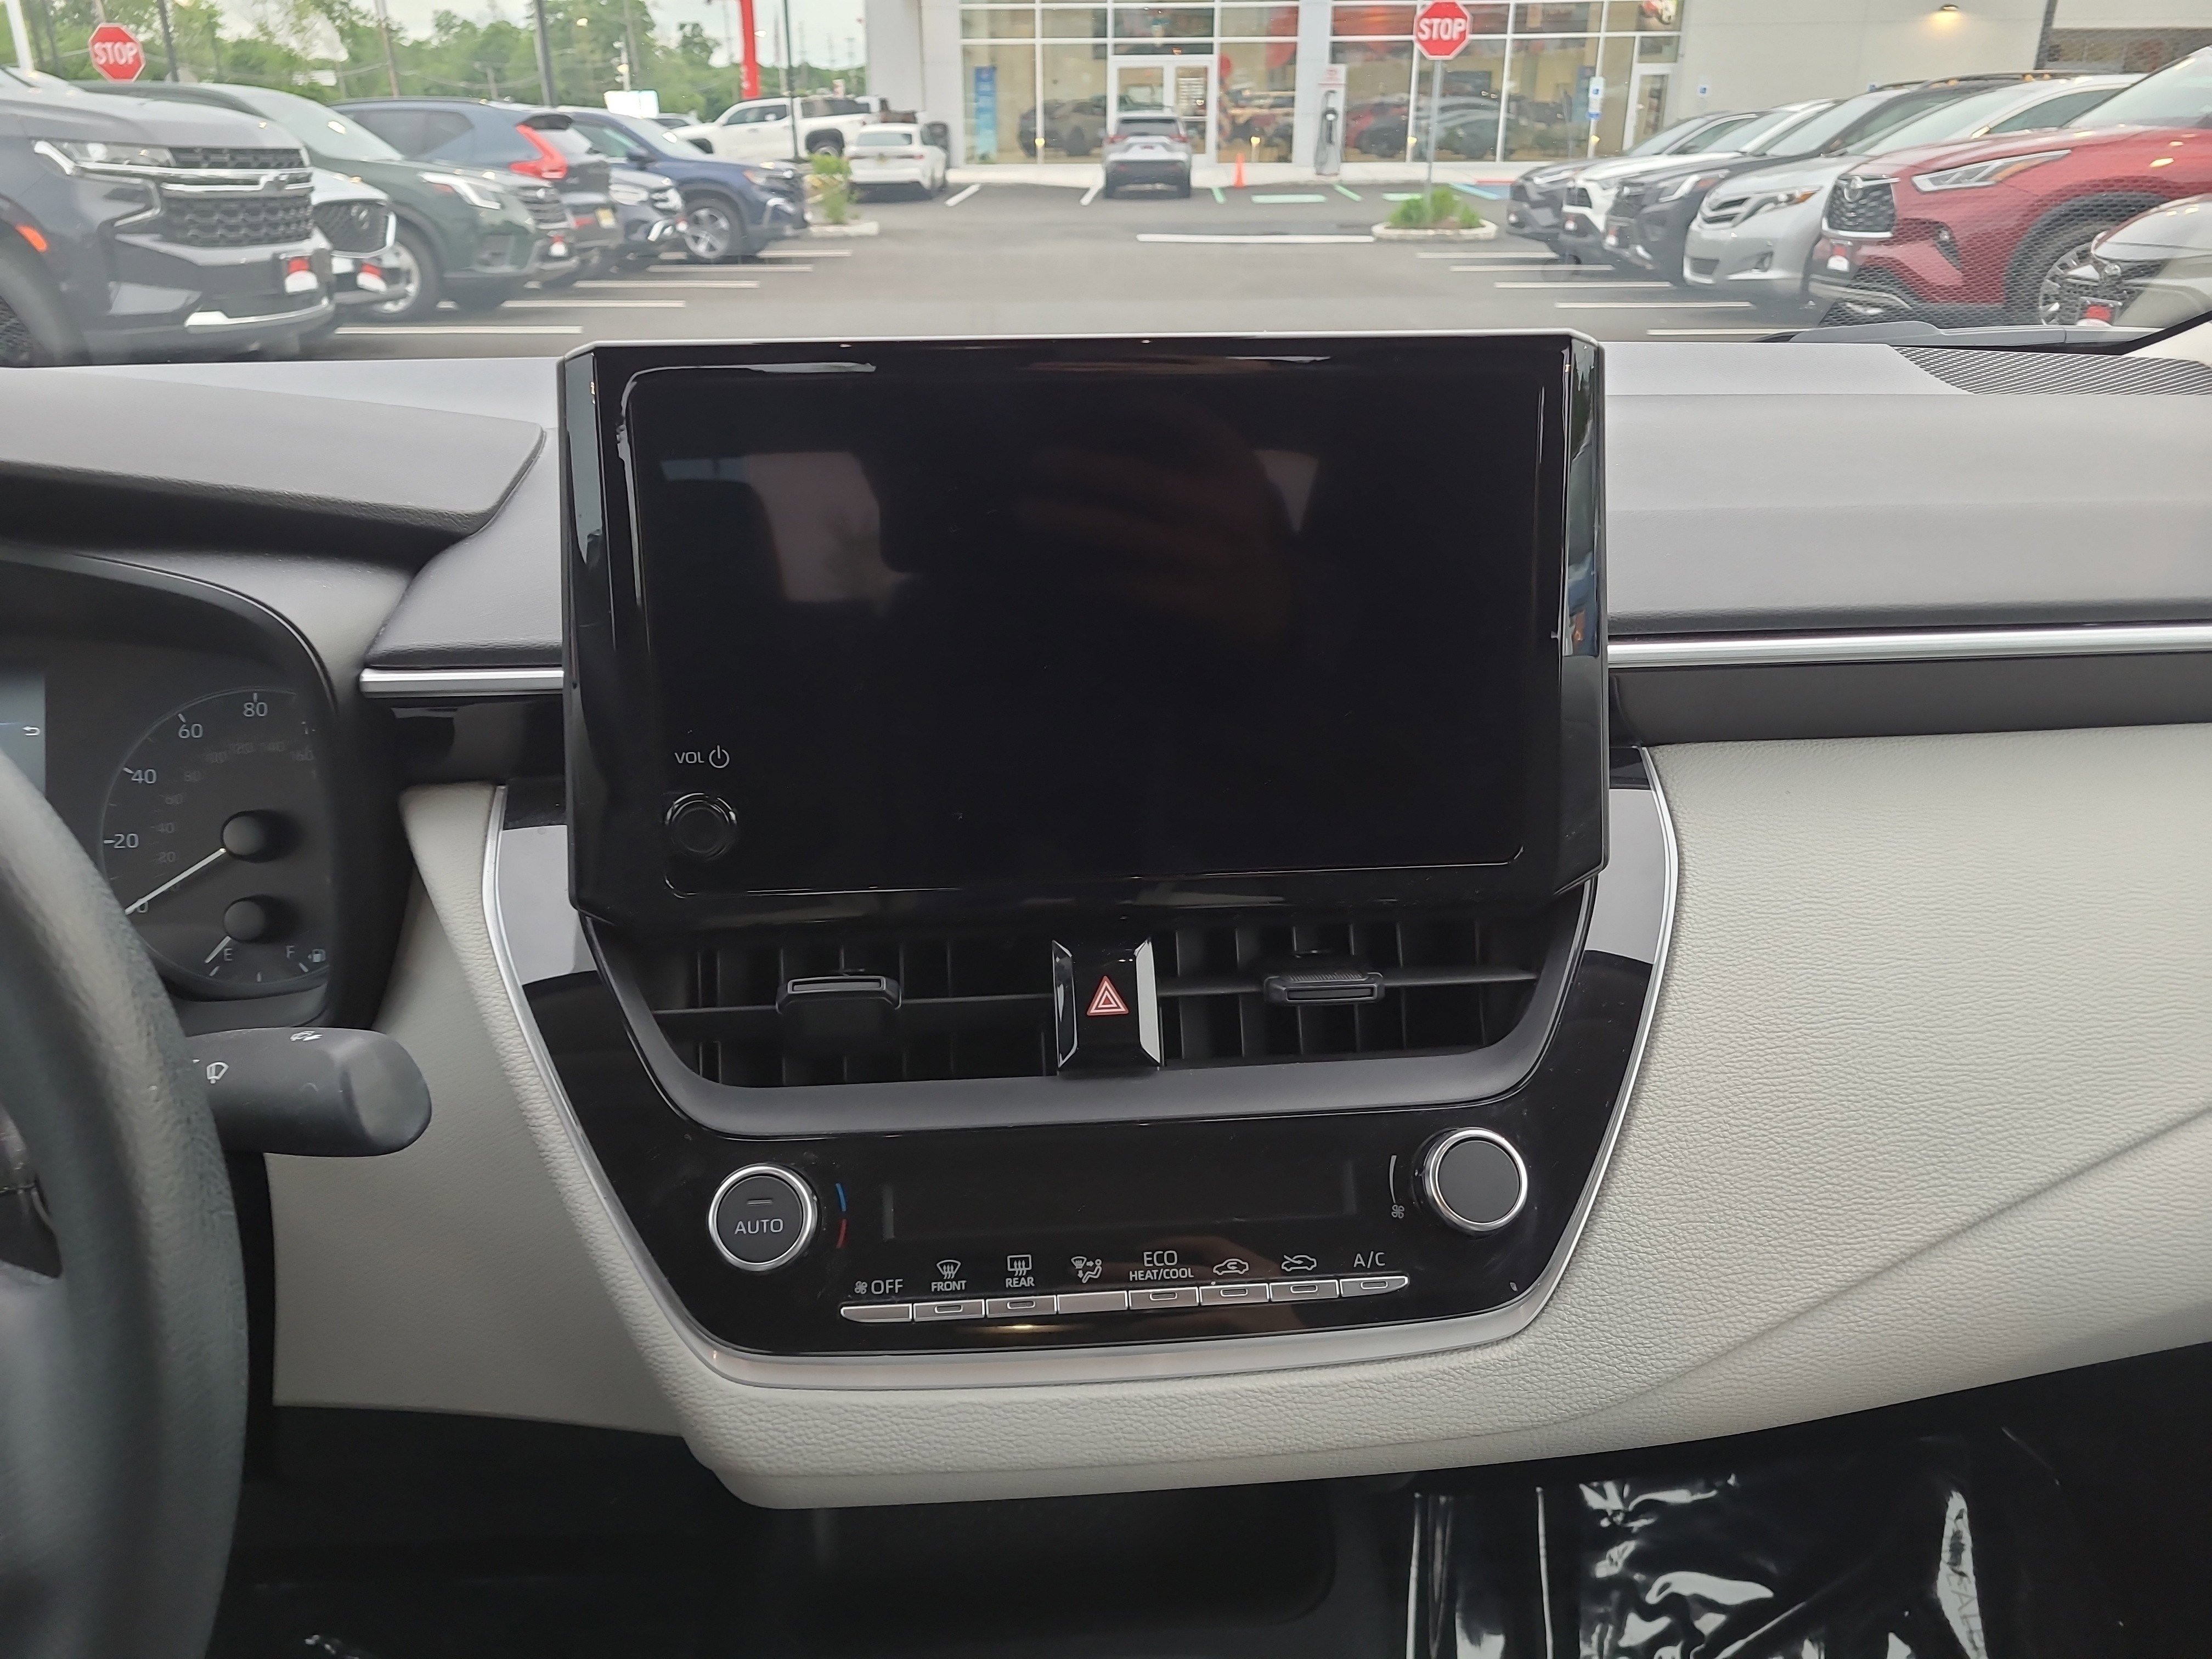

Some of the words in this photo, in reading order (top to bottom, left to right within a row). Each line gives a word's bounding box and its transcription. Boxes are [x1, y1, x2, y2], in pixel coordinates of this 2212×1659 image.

[1417, 18, 1466, 41] STOP
[93, 41, 138, 65] STOP
[242, 702, 268, 716] 80
[178, 724, 204, 738] 60
[674, 751, 704, 764] VOL
[131, 769, 157, 783] 40
[113, 833, 139, 849] 20
[224, 948, 233, 961] E
[286, 945, 295, 958] F
[734, 1217, 784, 1235] AUTO
[1143, 1250, 1178, 1268] ECO
[1353, 1251, 1386, 1269] A/C
[1128, 1267, 1194, 1282] HEAT/COOL
[871, 1279, 904, 1295] OFF
[931, 1279, 967, 1293] FRONT
[1005, 1276, 1035, 1288] REAR
